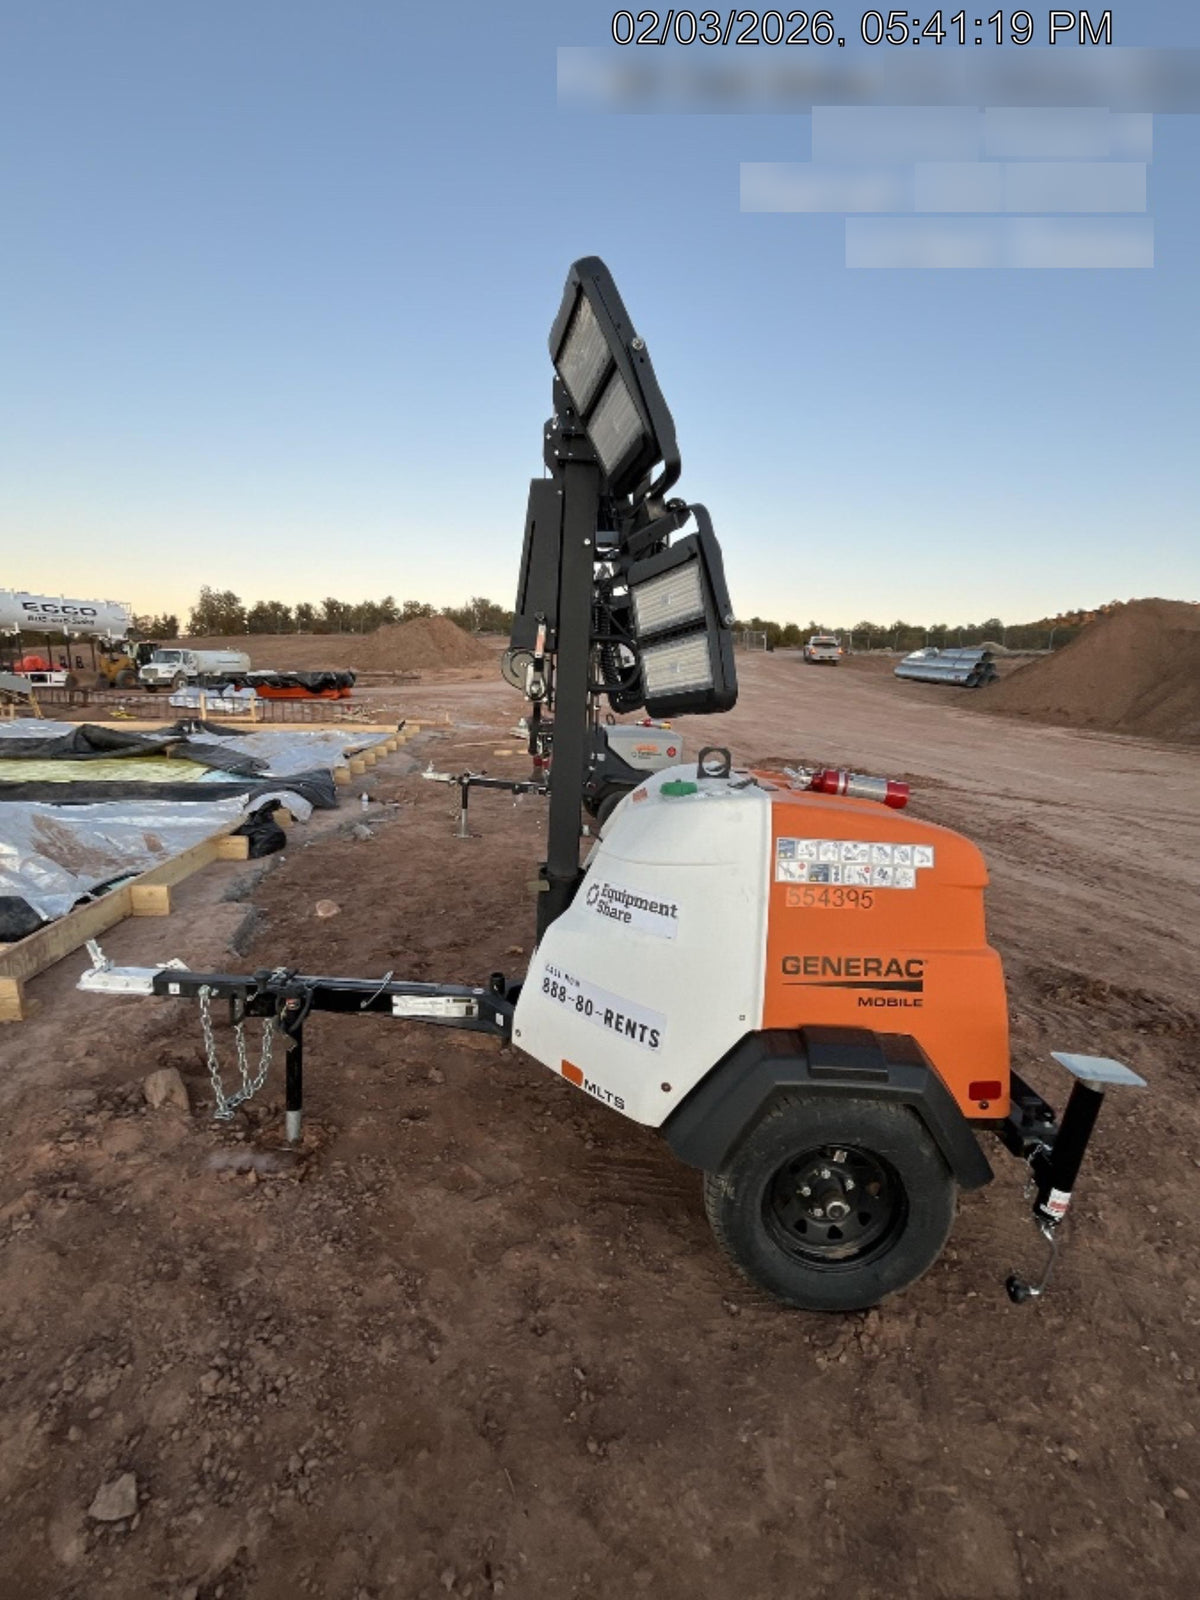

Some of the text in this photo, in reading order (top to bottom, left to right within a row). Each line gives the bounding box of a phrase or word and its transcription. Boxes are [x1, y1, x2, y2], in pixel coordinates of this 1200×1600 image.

[596, 898, 633, 924] Share
[600, 882, 679, 919] Equipment
[787, 887, 874, 909] 554395
[781, 956, 924, 978] GENERAC
[541, 977, 661, 1049] 888-80-RENTS
[857, 997, 924, 1008] MOBILE
[583, 1079, 625, 1111] MLTS
